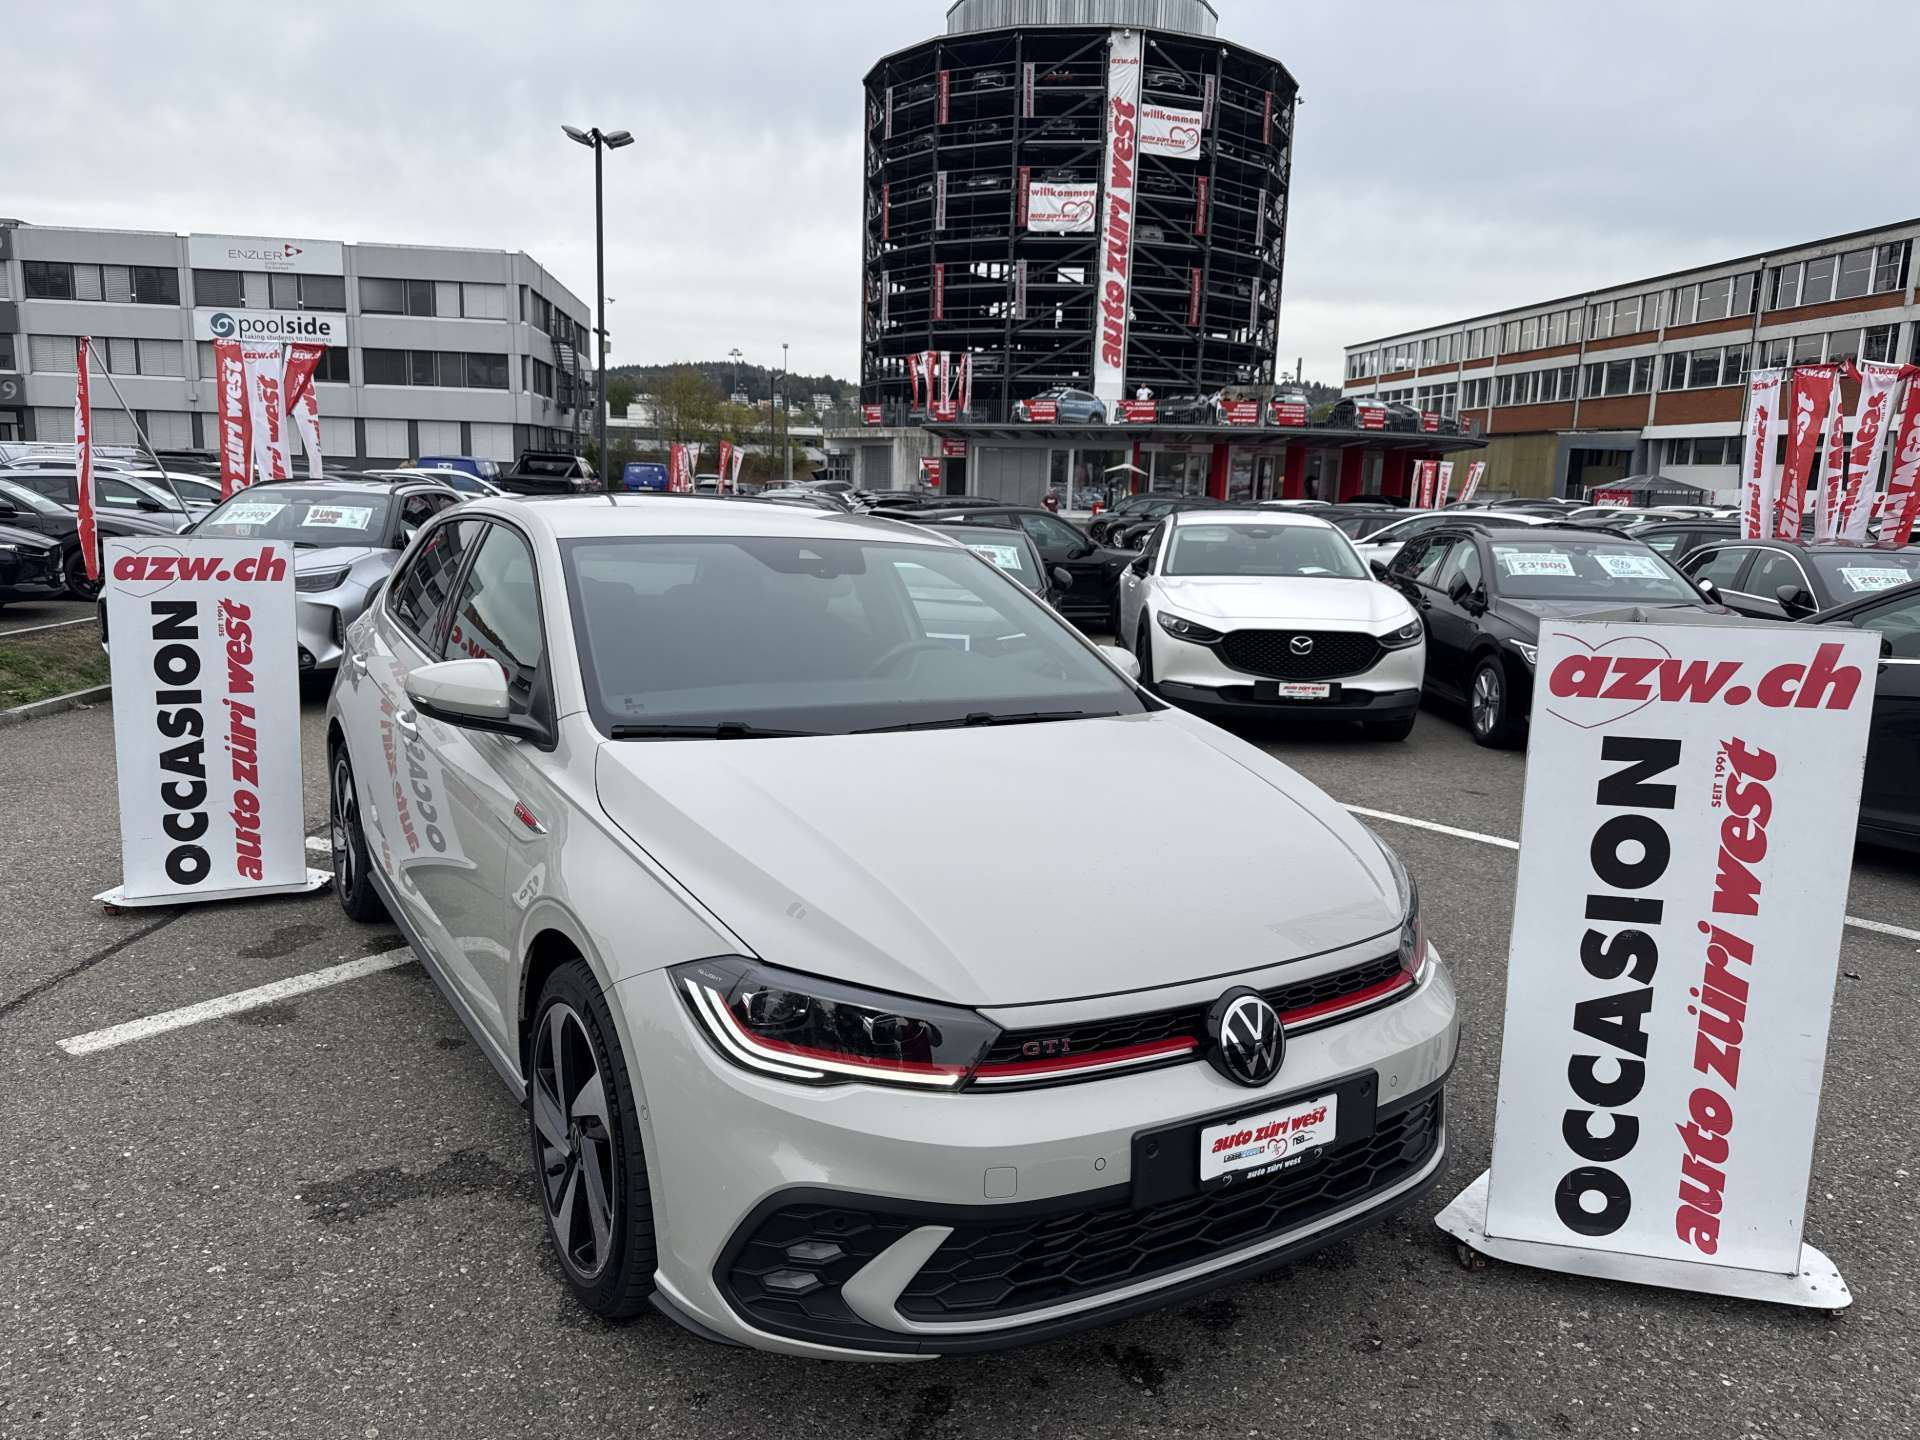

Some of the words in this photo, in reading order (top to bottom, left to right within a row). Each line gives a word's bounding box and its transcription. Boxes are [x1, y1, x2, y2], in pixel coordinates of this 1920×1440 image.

[1111, 56, 1139, 65] azw.ch
[1111, 96, 1136, 188] west
[1142, 109, 1201, 125] willkommen
[1031, 187, 1095, 197] willkommen
[228, 249, 283, 261] ENZLER
[1103, 192, 1131, 279] züri
[239, 315, 332, 339] poolside
[266, 334, 295, 342] students
[304, 335, 332, 343] business
[1100, 280, 1126, 369] auto
[244, 350, 281, 359] azw.ch
[223, 357, 243, 418] west
[257, 374, 279, 443] west
[224, 421, 246, 478] züri
[113, 546, 287, 582] azw.ch
[217, 623, 225, 638] SEIT
[218, 597, 255, 694] west
[1549, 643, 1862, 710] azw.ch
[151, 600, 212, 886] OCCASION
[223, 698, 259, 789] züri
[1714, 749, 1727, 780] 1991
[1711, 782, 1724, 808] SEIT
[228, 789, 263, 882] auto
[1711, 736, 1777, 916] west
[1554, 736, 1682, 1237] OCCASION
[1687, 920, 1755, 1090] züri
[1022, 1037, 1071, 1057] GTI
[1212, 1129, 1253, 1153] auto
[1253, 1117, 1291, 1142] züri
[1291, 1106, 1328, 1131] west
[1246, 1167, 1266, 1180] auto
[1266, 1161, 1284, 1173] züri
[1284, 1156, 1302, 1169] west
[1675, 1088, 1733, 1256] auto
